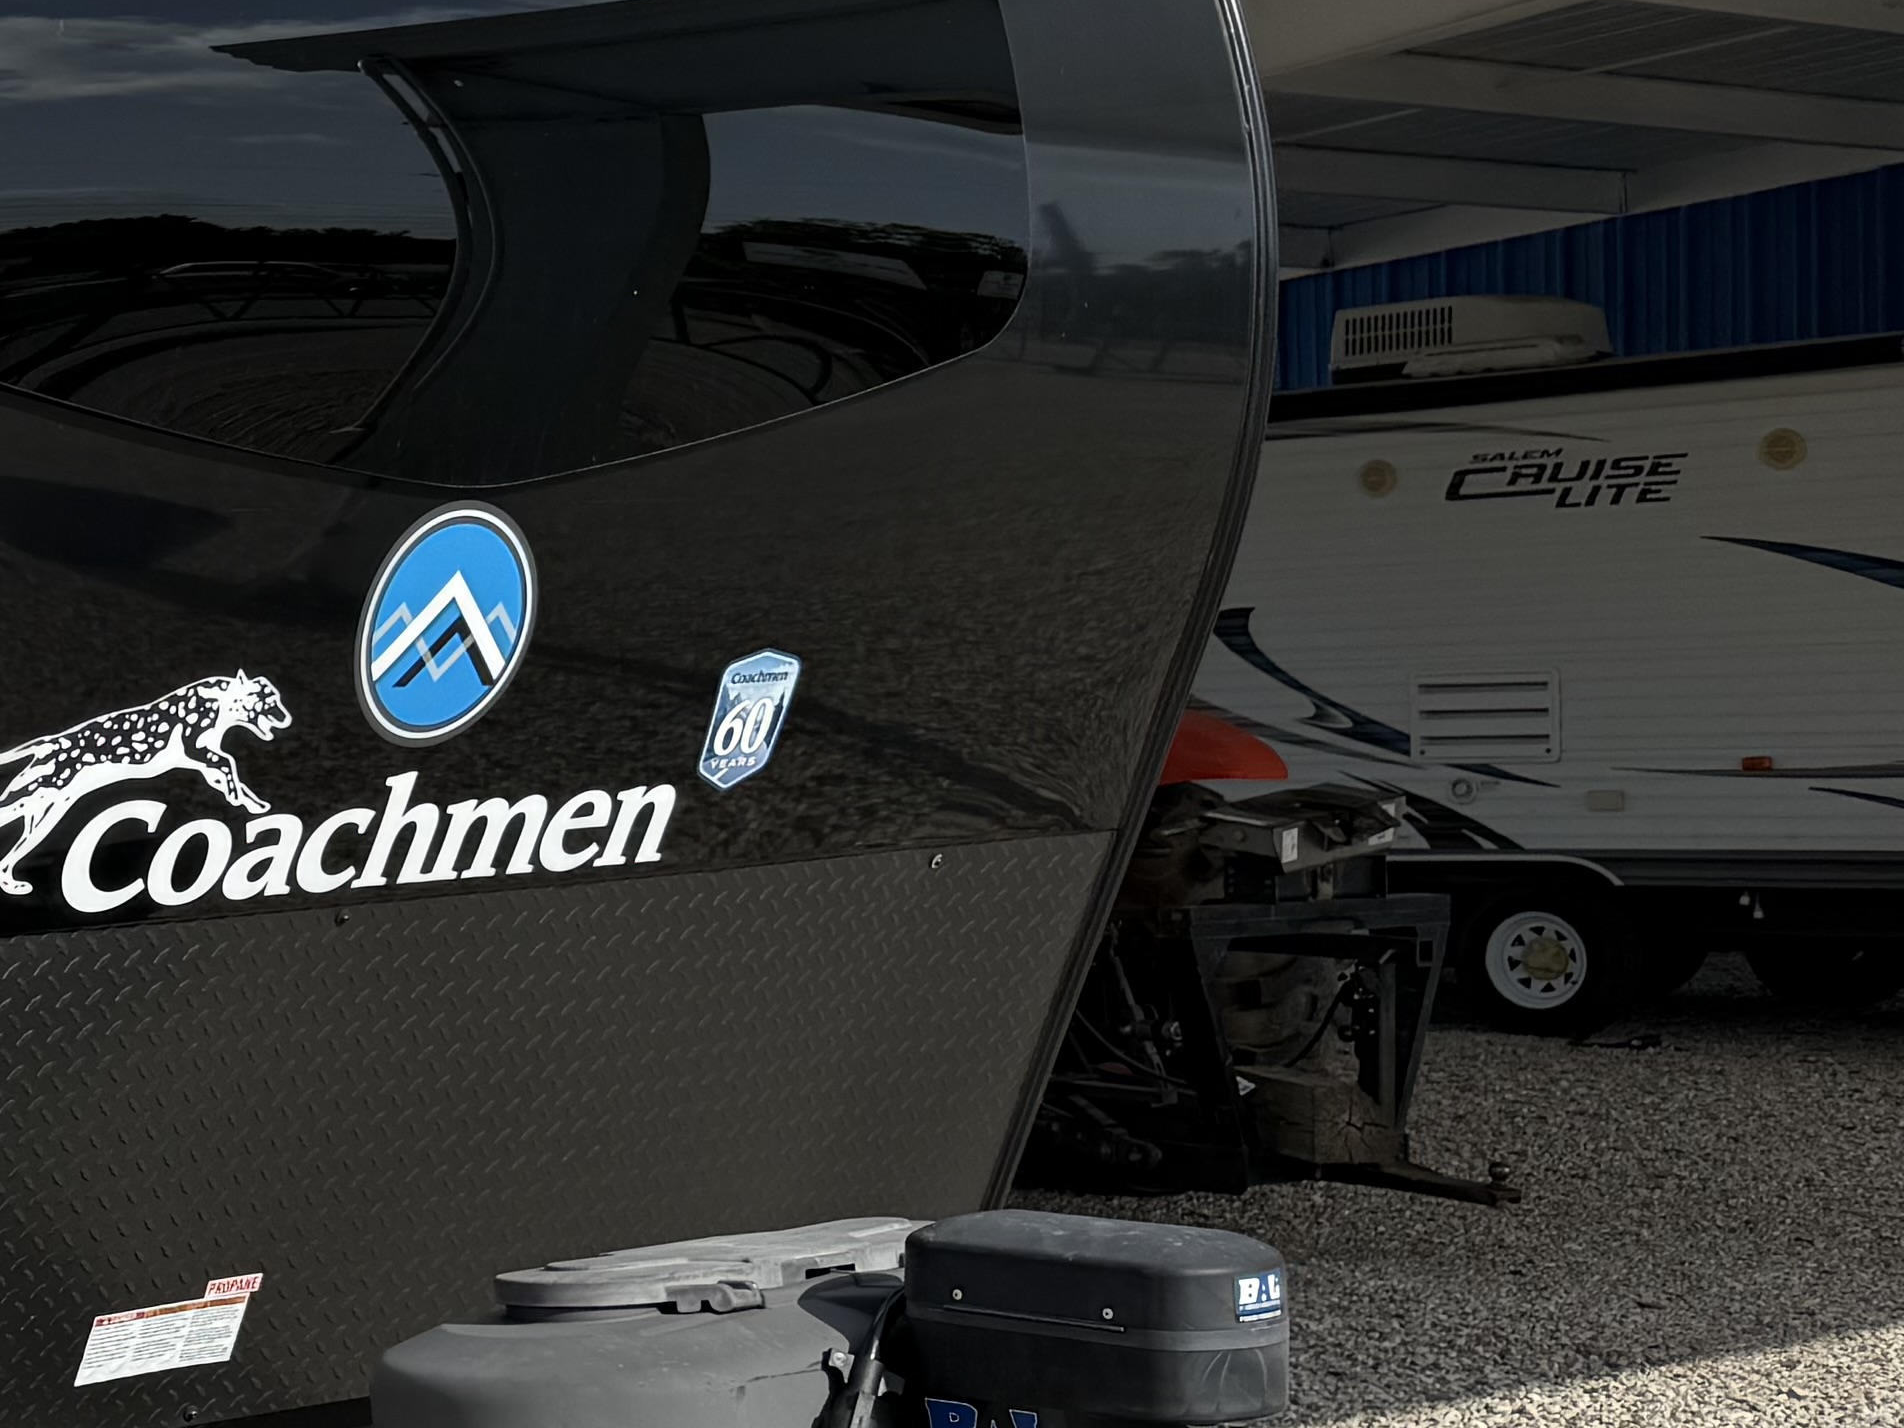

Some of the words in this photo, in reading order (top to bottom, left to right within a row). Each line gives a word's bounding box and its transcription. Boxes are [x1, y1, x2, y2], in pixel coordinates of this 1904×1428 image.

[1469, 448, 1564, 465] SALEM
[1445, 452, 1689, 501] CRUISE
[1555, 479, 1678, 509] LITE
[730, 669, 789, 684] Coachmen
[713, 698, 775, 756] 60
[711, 756, 758, 770] YEARS
[60, 770, 677, 914] Coachmen
[1238, 1273, 1281, 1305] BAL
